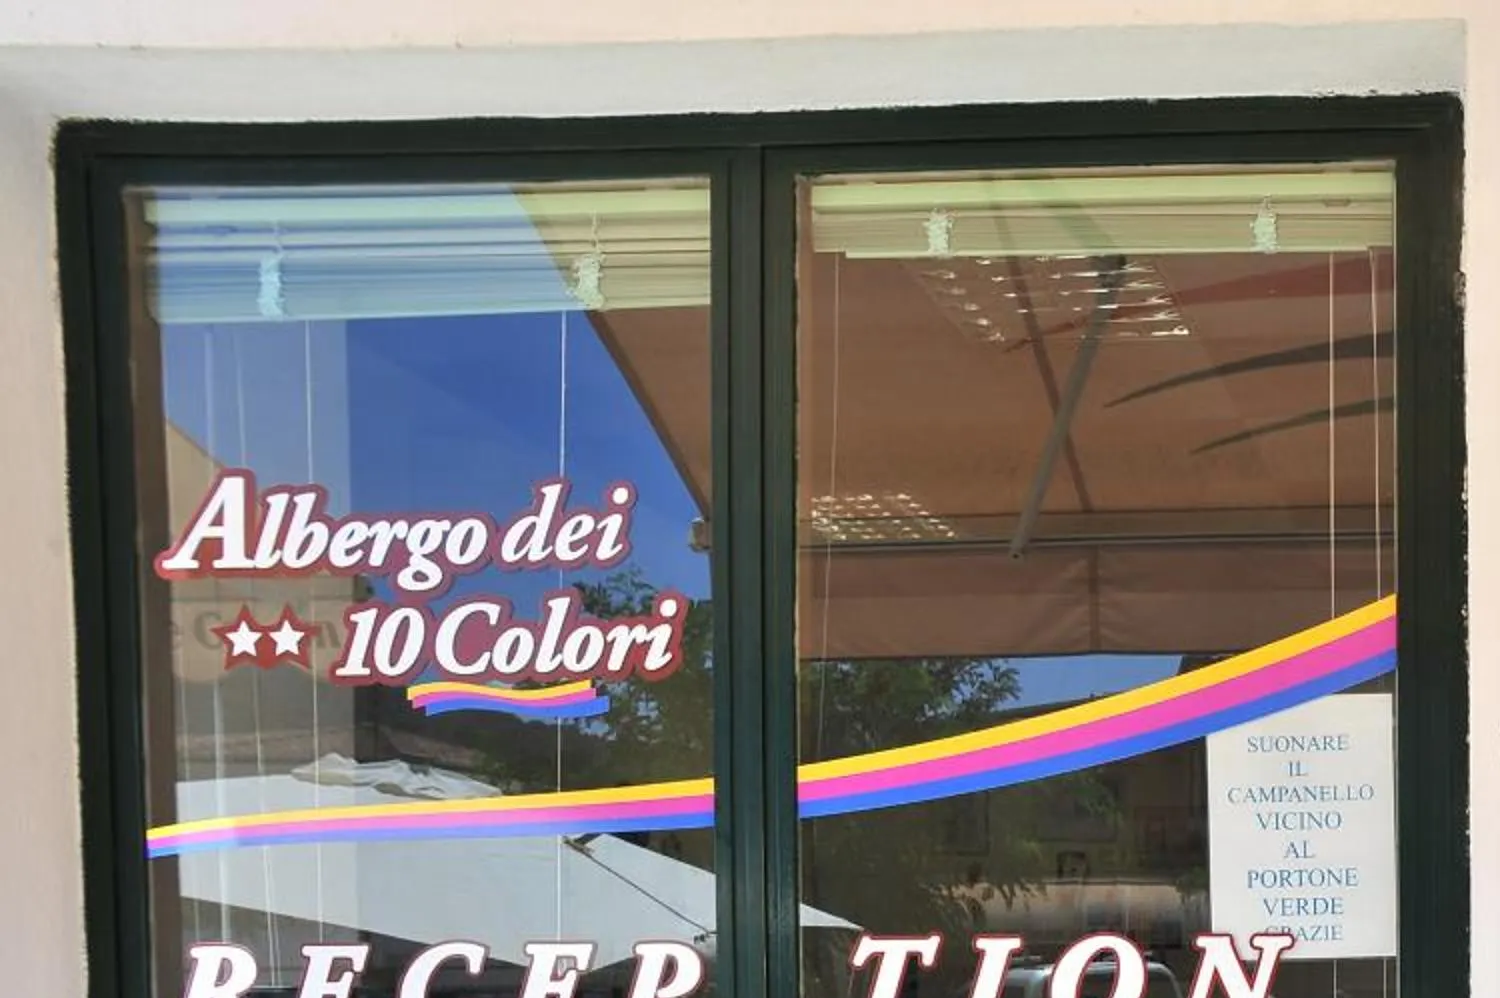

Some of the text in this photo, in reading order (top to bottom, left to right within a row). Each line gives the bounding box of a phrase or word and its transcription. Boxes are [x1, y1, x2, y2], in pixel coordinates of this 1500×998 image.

[158, 473, 633, 593] Albergo dei
[334, 604, 427, 678] 10
[433, 596, 680, 678] Colori
[1247, 735, 1350, 753] SUONARE
[1288, 761, 1309, 777] IL
[1227, 784, 1374, 804] CAMPANELLO
[1256, 812, 1342, 831] VICINO
[1284, 840, 1316, 859] AL
[1247, 868, 1359, 888] PORTONE
[1263, 897, 1344, 916] VERDE
